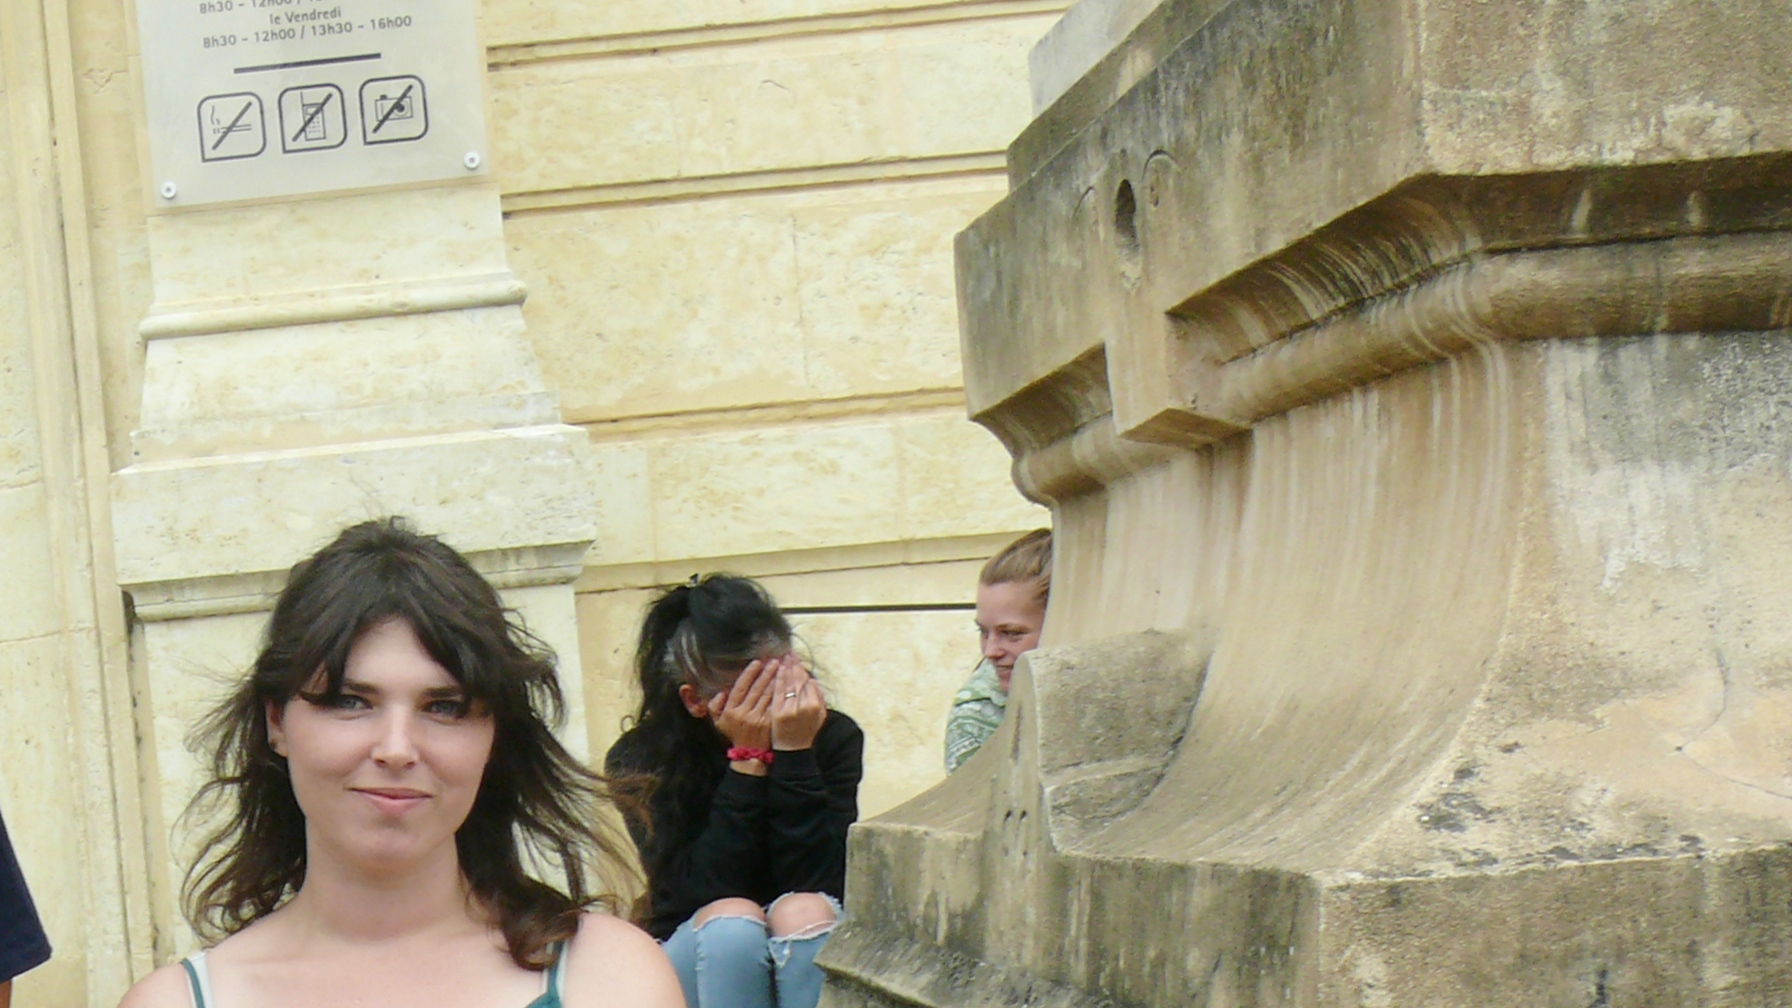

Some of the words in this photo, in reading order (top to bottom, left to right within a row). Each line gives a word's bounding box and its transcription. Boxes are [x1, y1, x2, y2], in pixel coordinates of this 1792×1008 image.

[199, 2, 233, 14] 8h30
[270, 14, 281, 25] le
[285, 7, 342, 24] Vendredi
[203, 34, 237, 49] 8h30
[254, 28, 296, 42] 12h00
[311, 22, 353, 36] 13h30
[370, 15, 412, 30] 16h00
